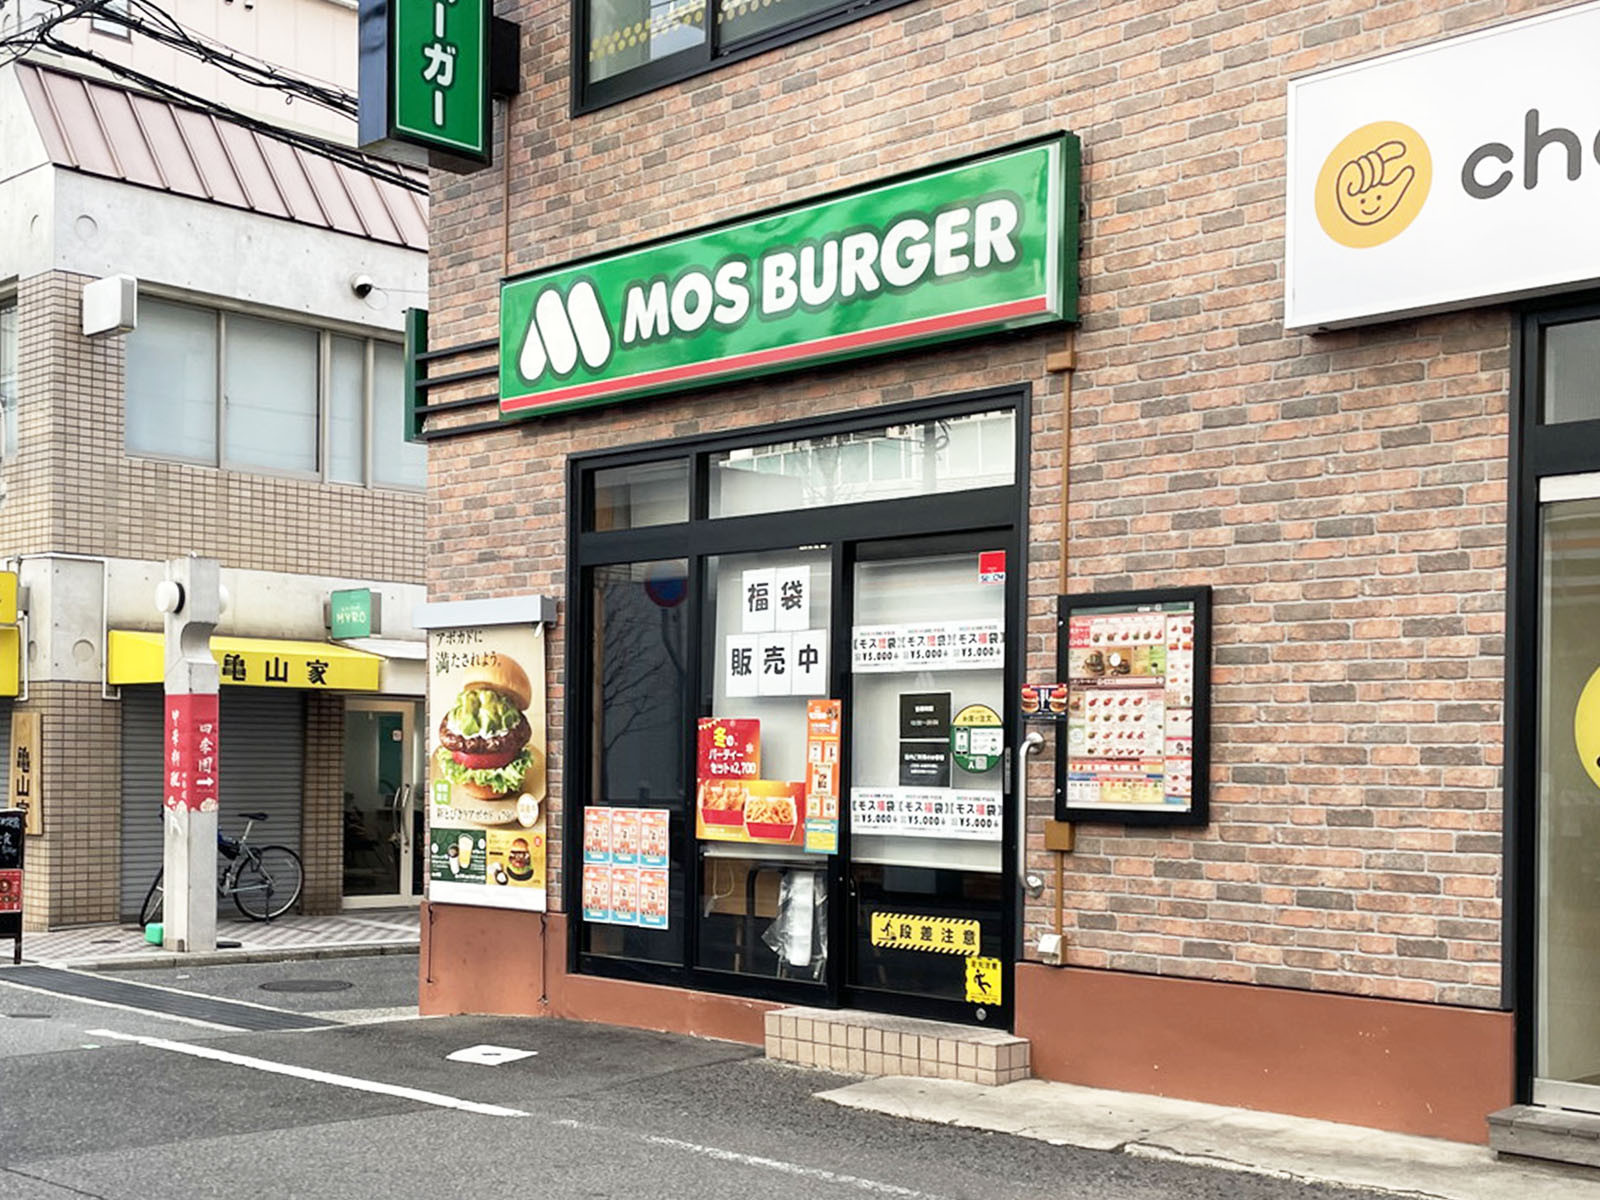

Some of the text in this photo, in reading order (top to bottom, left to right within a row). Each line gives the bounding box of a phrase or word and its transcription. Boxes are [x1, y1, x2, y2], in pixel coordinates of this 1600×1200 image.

[423, 0, 457, 126] ーガー
[1461, 108, 1600, 200] ch
[622, 199, 1019, 345] MOS BURGER
[747, 580, 803, 613] 福袋
[222, 653, 329, 685] 亀山家
[731, 643, 820, 677] 販売中
[899, 923, 976, 945] 段差注意
